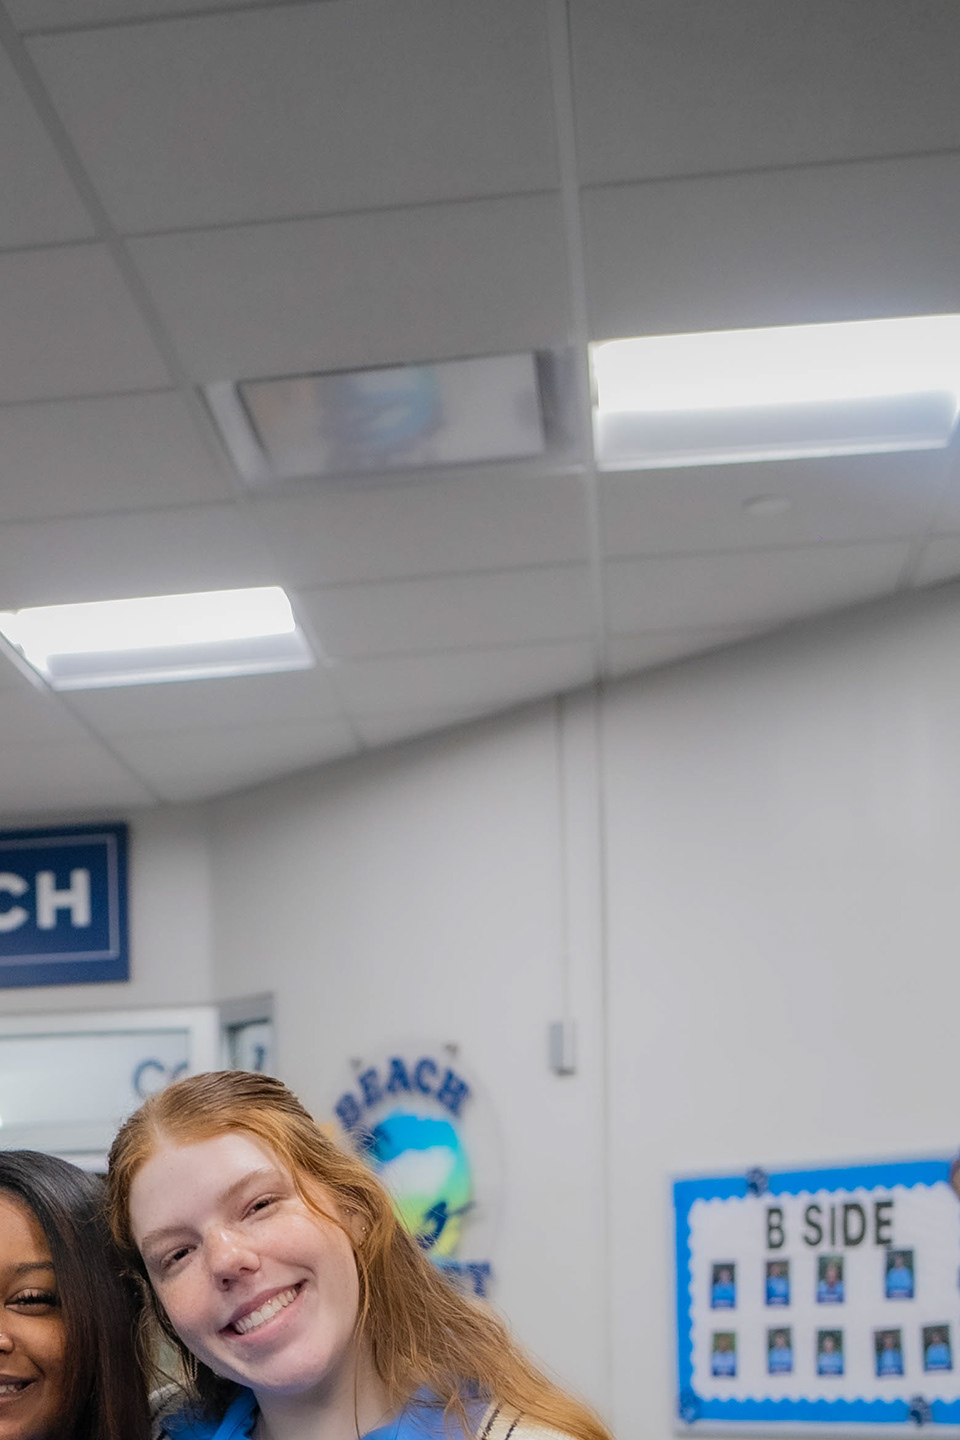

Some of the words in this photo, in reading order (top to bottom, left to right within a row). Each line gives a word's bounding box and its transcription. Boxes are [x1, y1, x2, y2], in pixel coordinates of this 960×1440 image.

[336, 1056, 470, 1131] BEACH
[767, 1207, 784, 1250] B
[803, 1200, 894, 1247] SIDE
